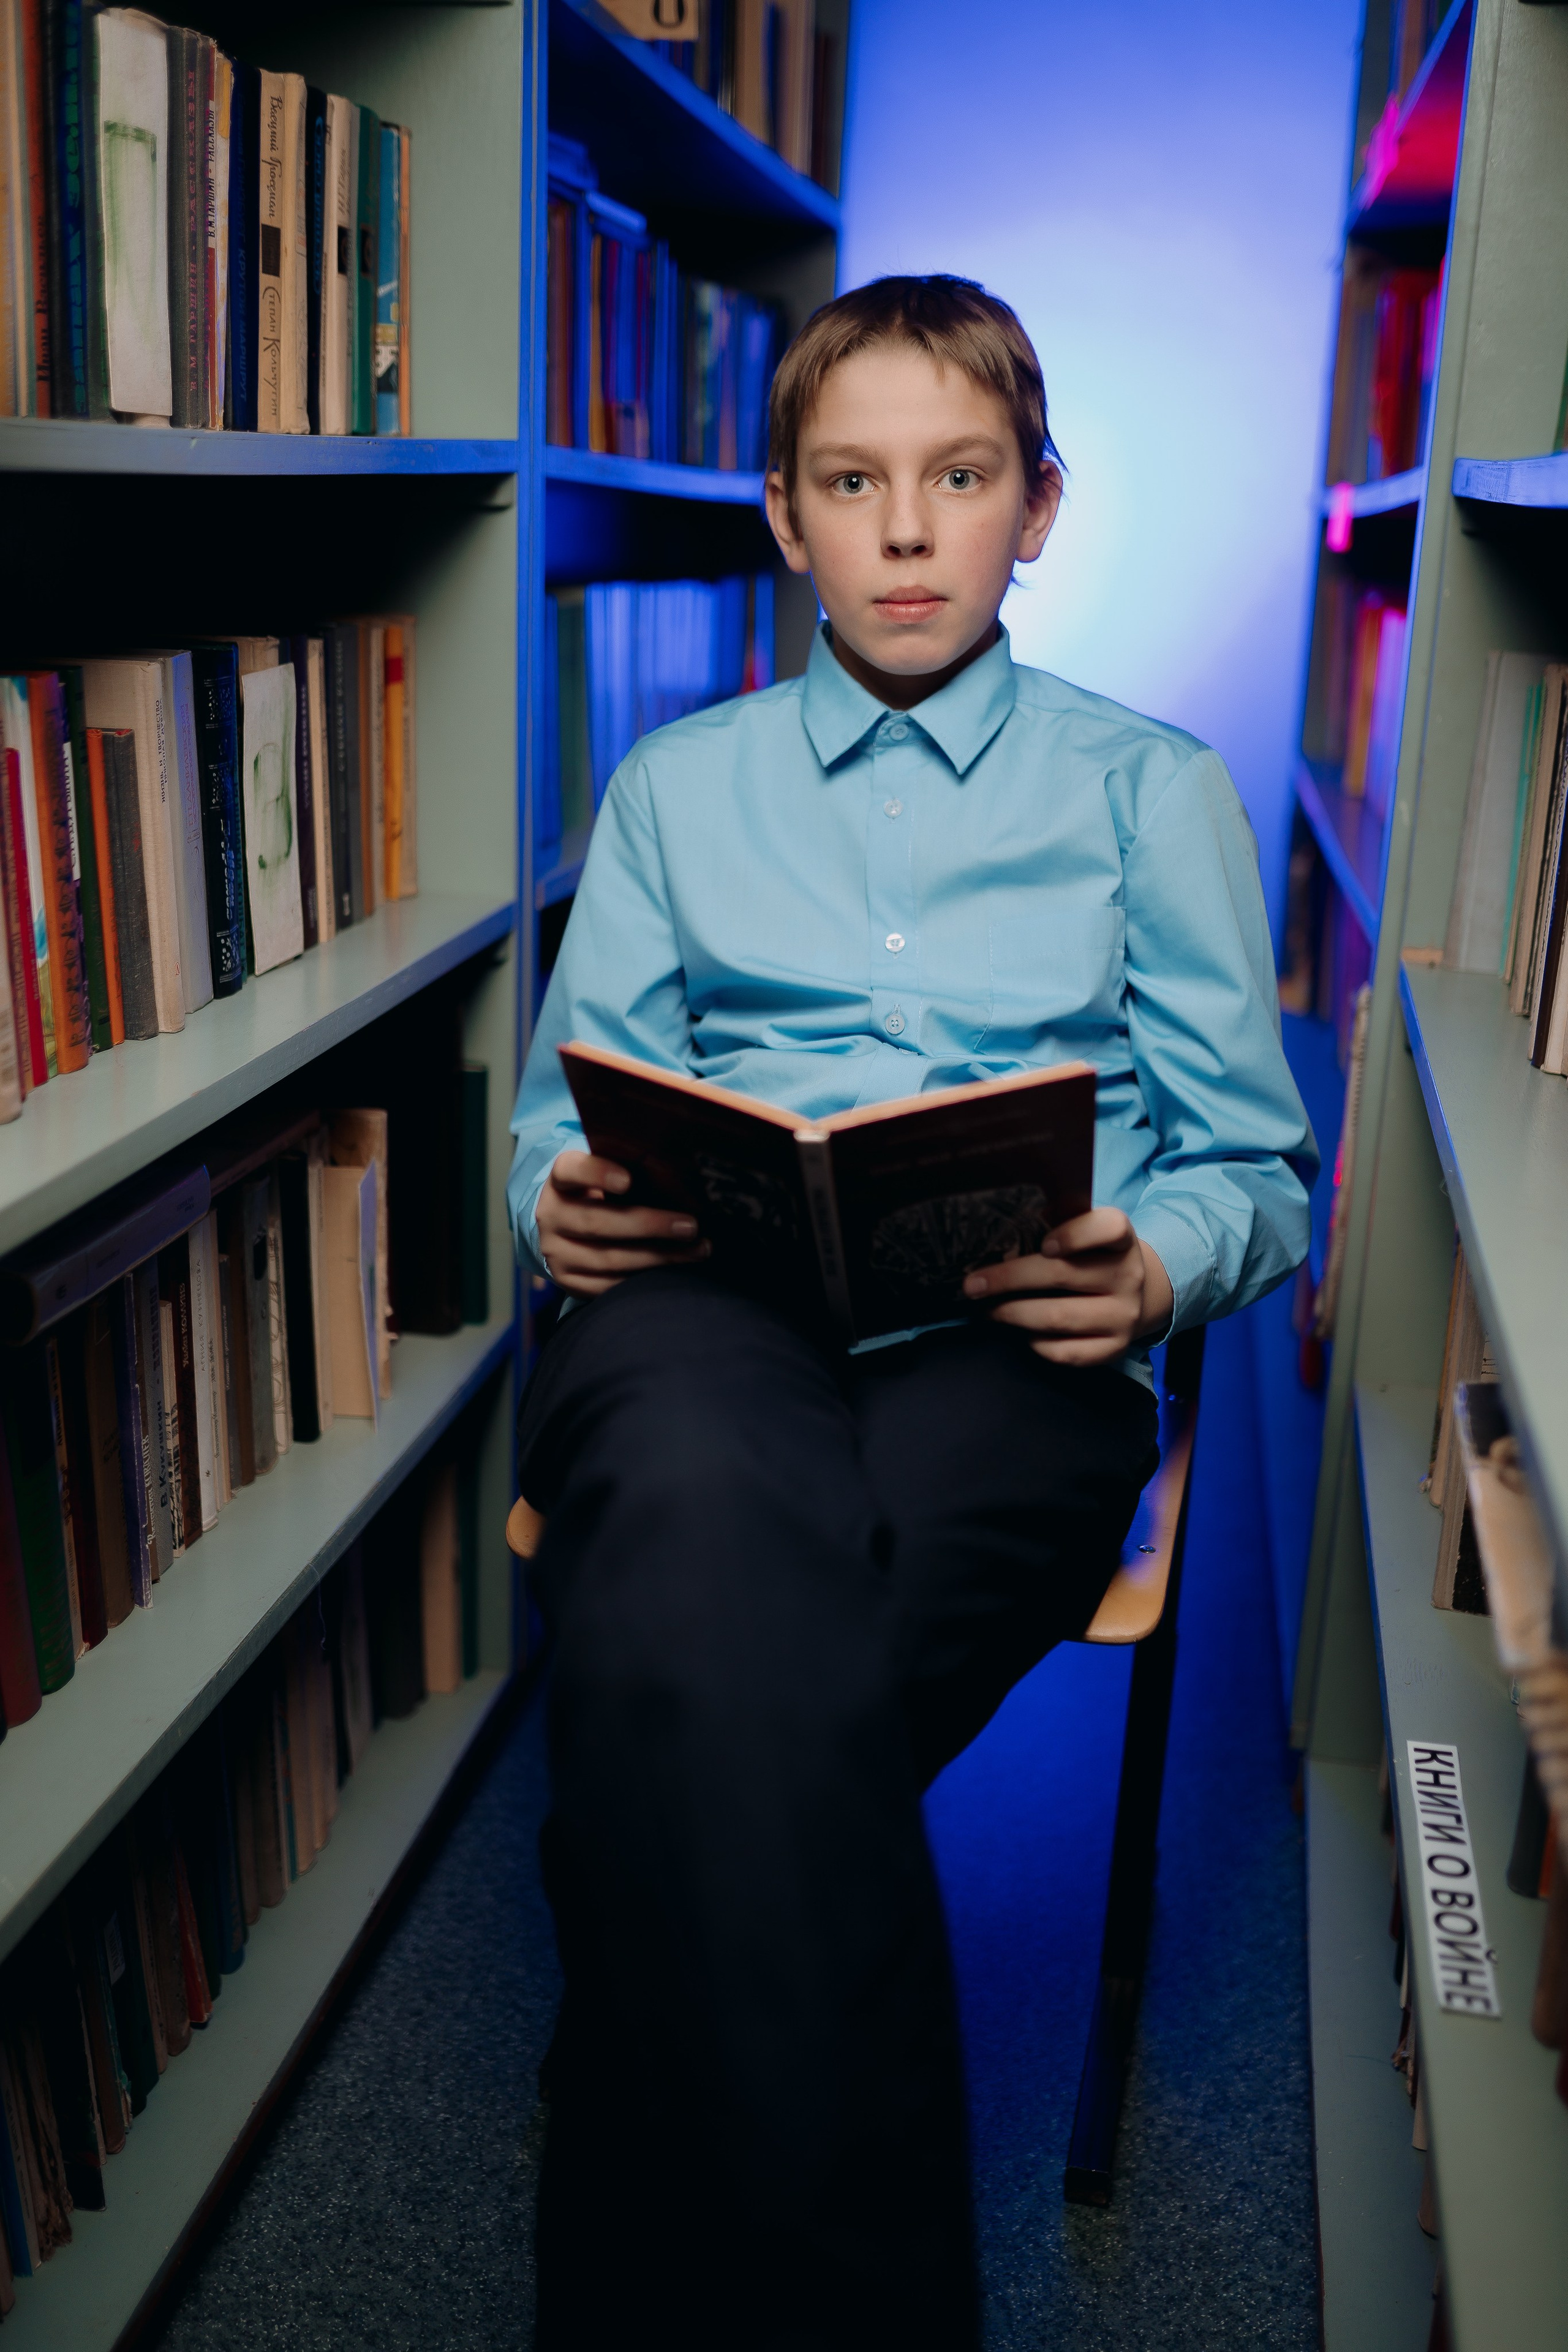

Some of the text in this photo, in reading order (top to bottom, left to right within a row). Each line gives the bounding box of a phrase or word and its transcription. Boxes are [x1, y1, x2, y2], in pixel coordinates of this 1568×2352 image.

[187, 70, 197, 232] РАССКАЗЫ
[1413, 1747, 1497, 2011] КНИГИ О ВОЙНЕ
